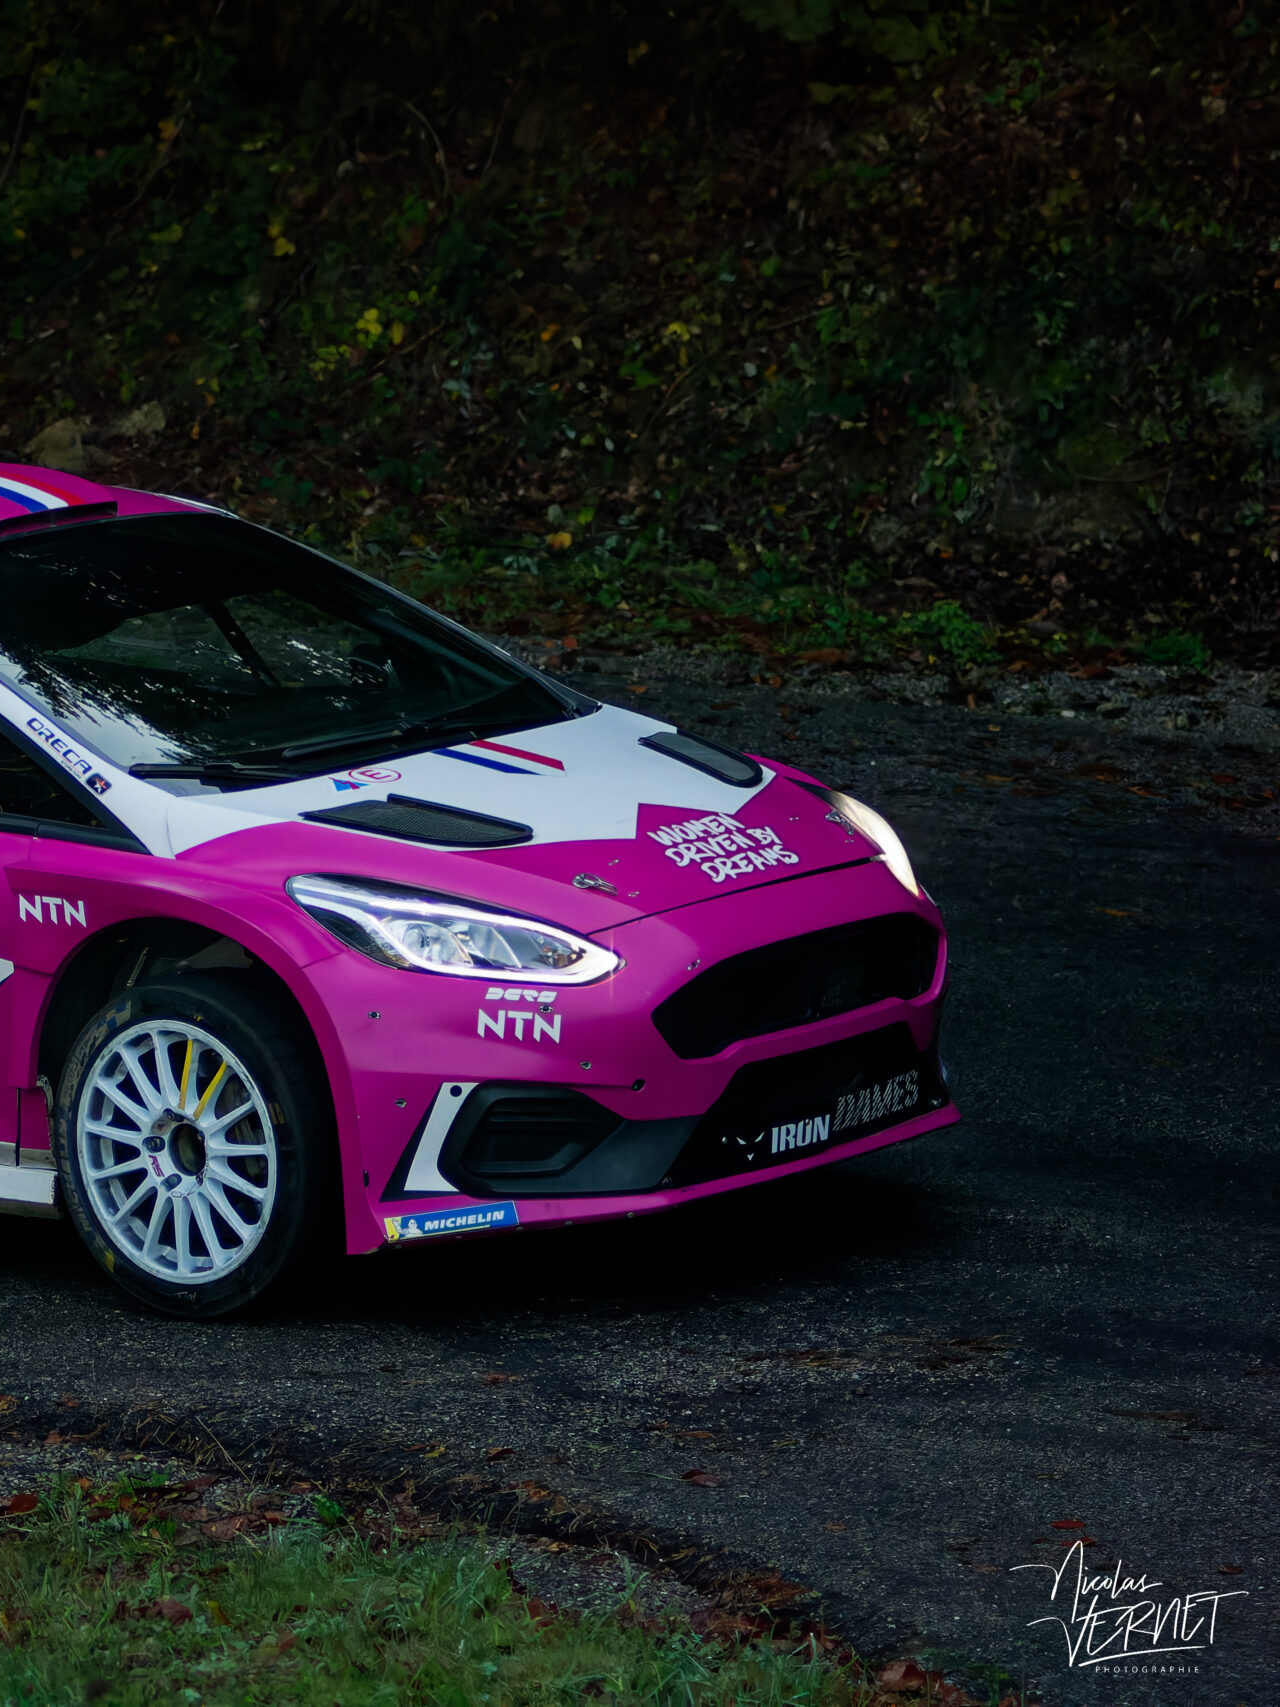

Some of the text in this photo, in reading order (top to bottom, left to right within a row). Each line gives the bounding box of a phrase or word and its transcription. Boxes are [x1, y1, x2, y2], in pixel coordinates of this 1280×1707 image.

[26, 717, 93, 775] ORECA
[646, 812, 746, 846] WOMEN
[664, 826, 783, 867] DRIVEN BY
[700, 845, 800, 883] DREAMS
[18, 893, 87, 928] NTN
[477, 1008, 562, 1044] NTN
[771, 1069, 919, 1154] IRON DAMES
[424, 1210, 505, 1232] MICHELIN
